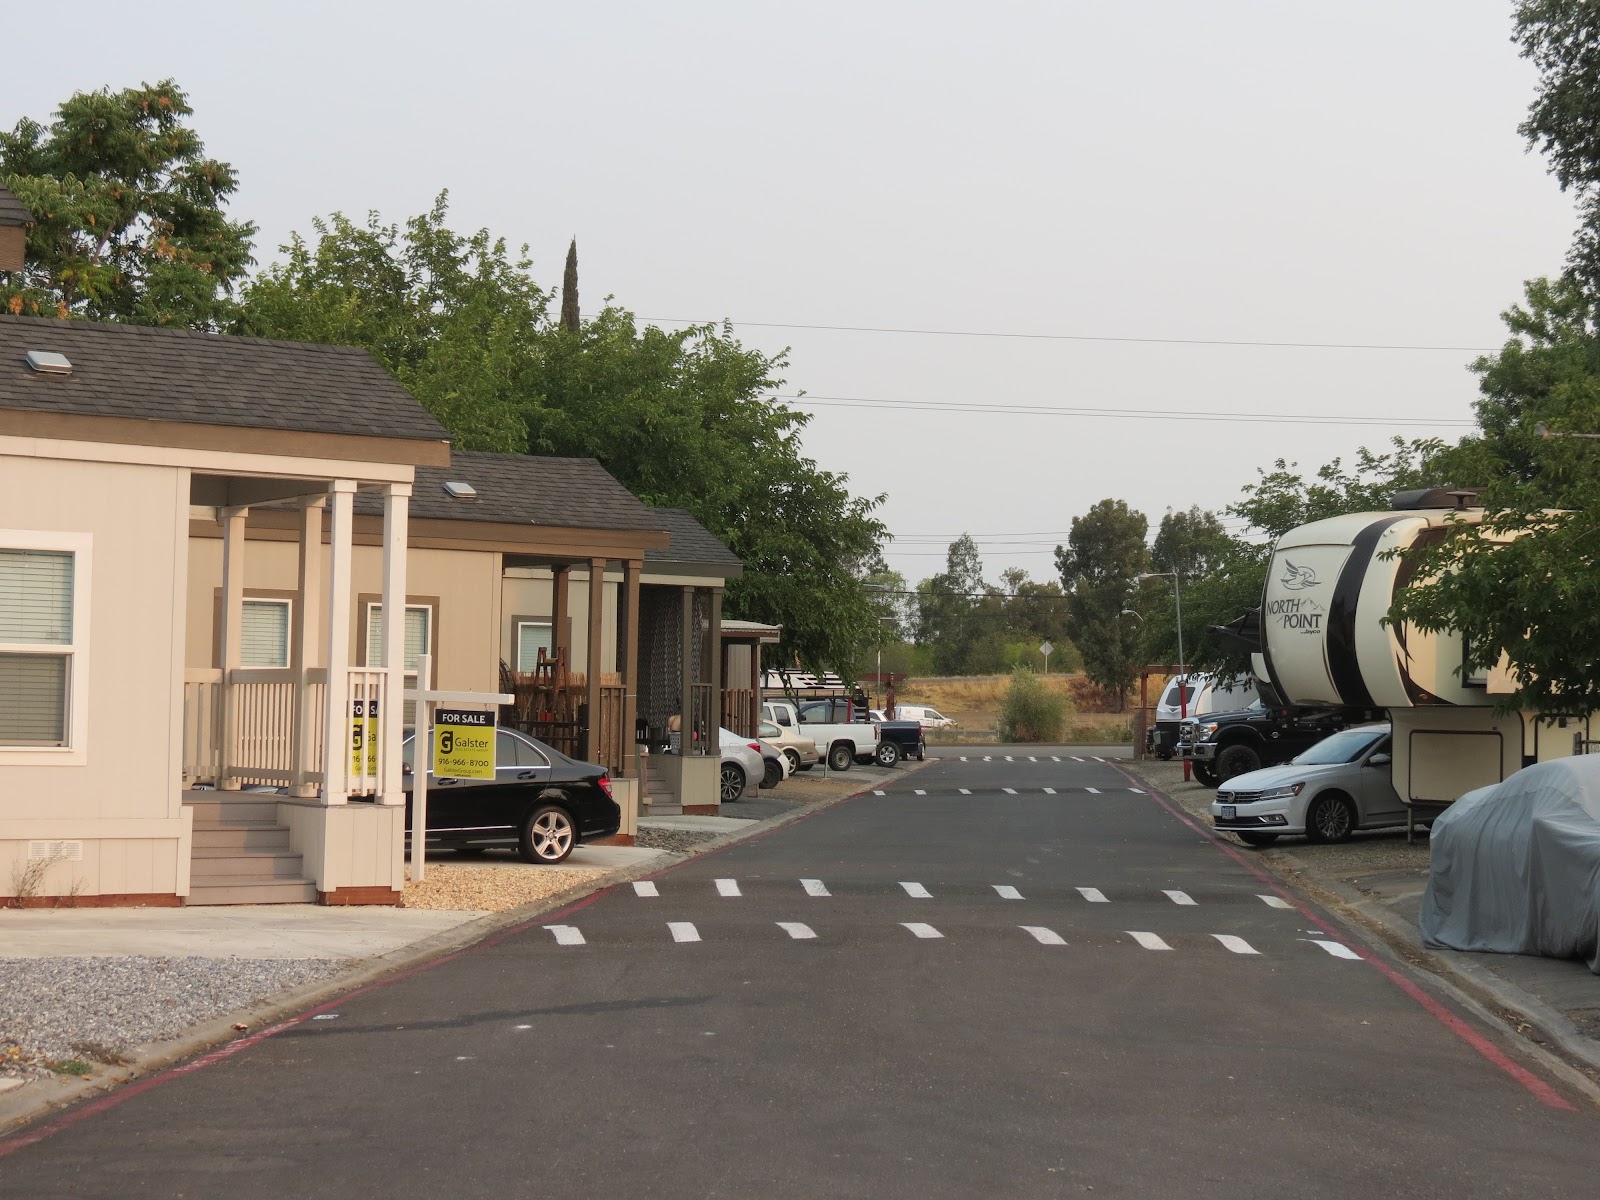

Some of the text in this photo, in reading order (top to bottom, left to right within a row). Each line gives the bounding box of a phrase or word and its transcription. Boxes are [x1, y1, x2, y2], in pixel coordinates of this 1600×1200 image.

[1266, 598, 1301, 616] NORTH
[1283, 613, 1322, 629] POINT
[442, 713, 486, 724] FOR SALE
[454, 737, 489, 748] Galster
